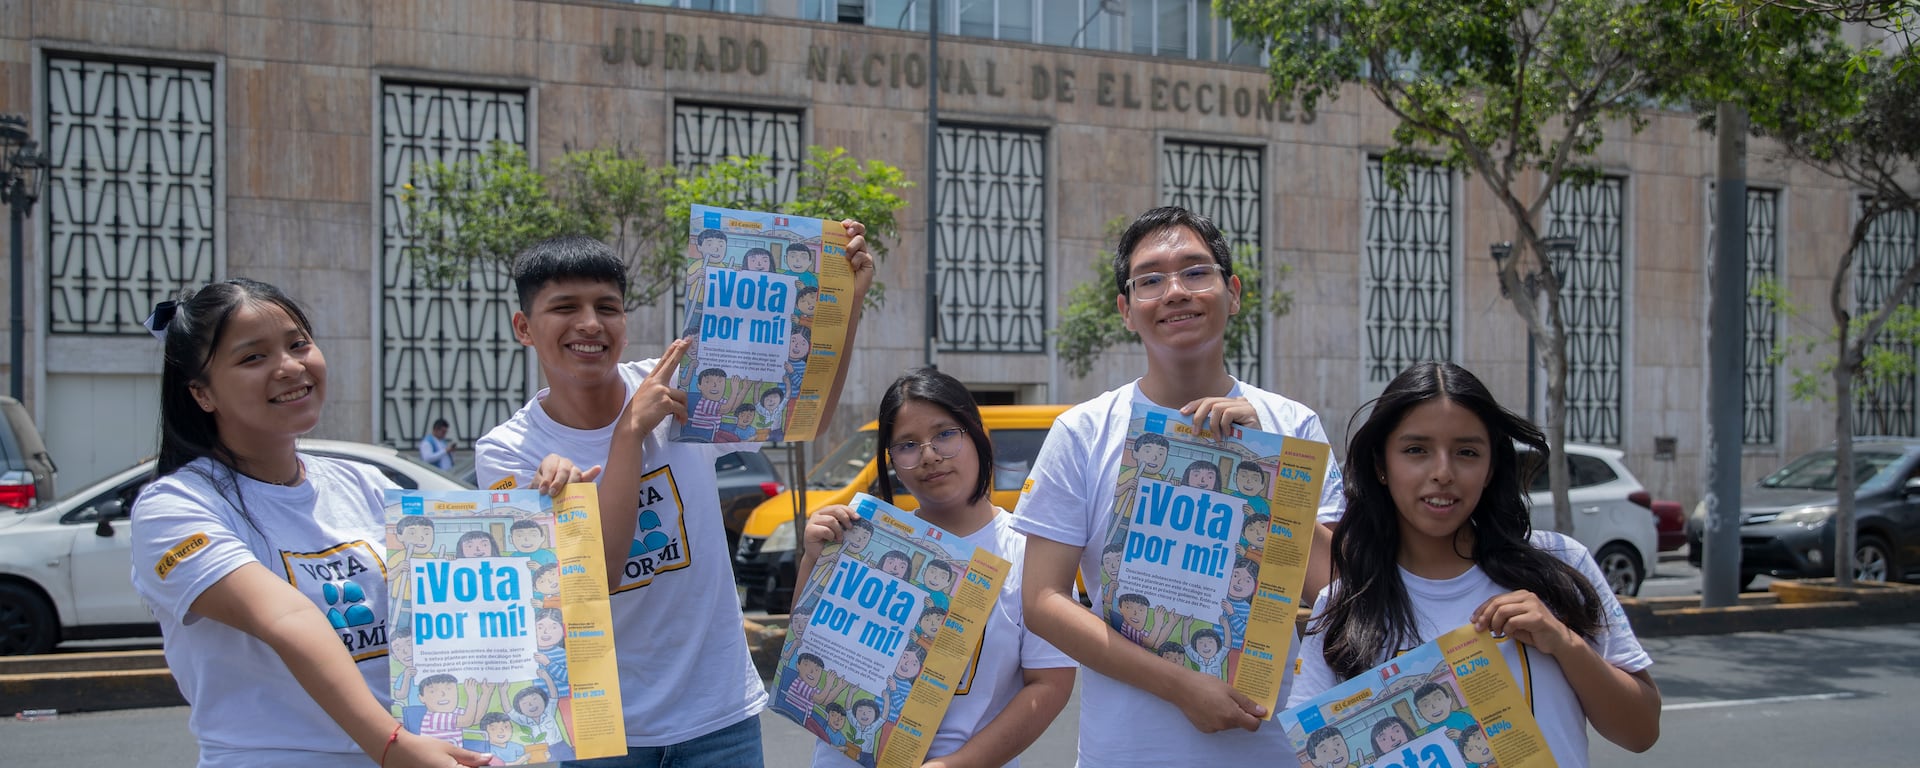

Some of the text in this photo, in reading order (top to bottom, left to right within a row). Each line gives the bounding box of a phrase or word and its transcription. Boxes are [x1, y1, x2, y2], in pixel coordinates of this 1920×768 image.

[600, 27, 1318, 125] JURADO NACIONAL DE ELECCIONES
[707, 270, 788, 313] ¡Vota
[701, 313, 787, 345] por mí!
[1134, 483, 1234, 542] ¡Vota
[158, 538, 204, 575] El Comercio
[299, 555, 368, 581] VOTA
[623, 557, 656, 579] OR
[1124, 530, 1229, 579] por mí!
[415, 560, 520, 605] ¡Vota
[827, 560, 916, 626] ¡Vota
[357, 619, 388, 649] MÍ
[415, 602, 528, 645] por mí!
[810, 599, 861, 637] por
[858, 620, 905, 658] mí!
[1456, 656, 1490, 677] 43,7%
[1485, 720, 1513, 738] 84%
